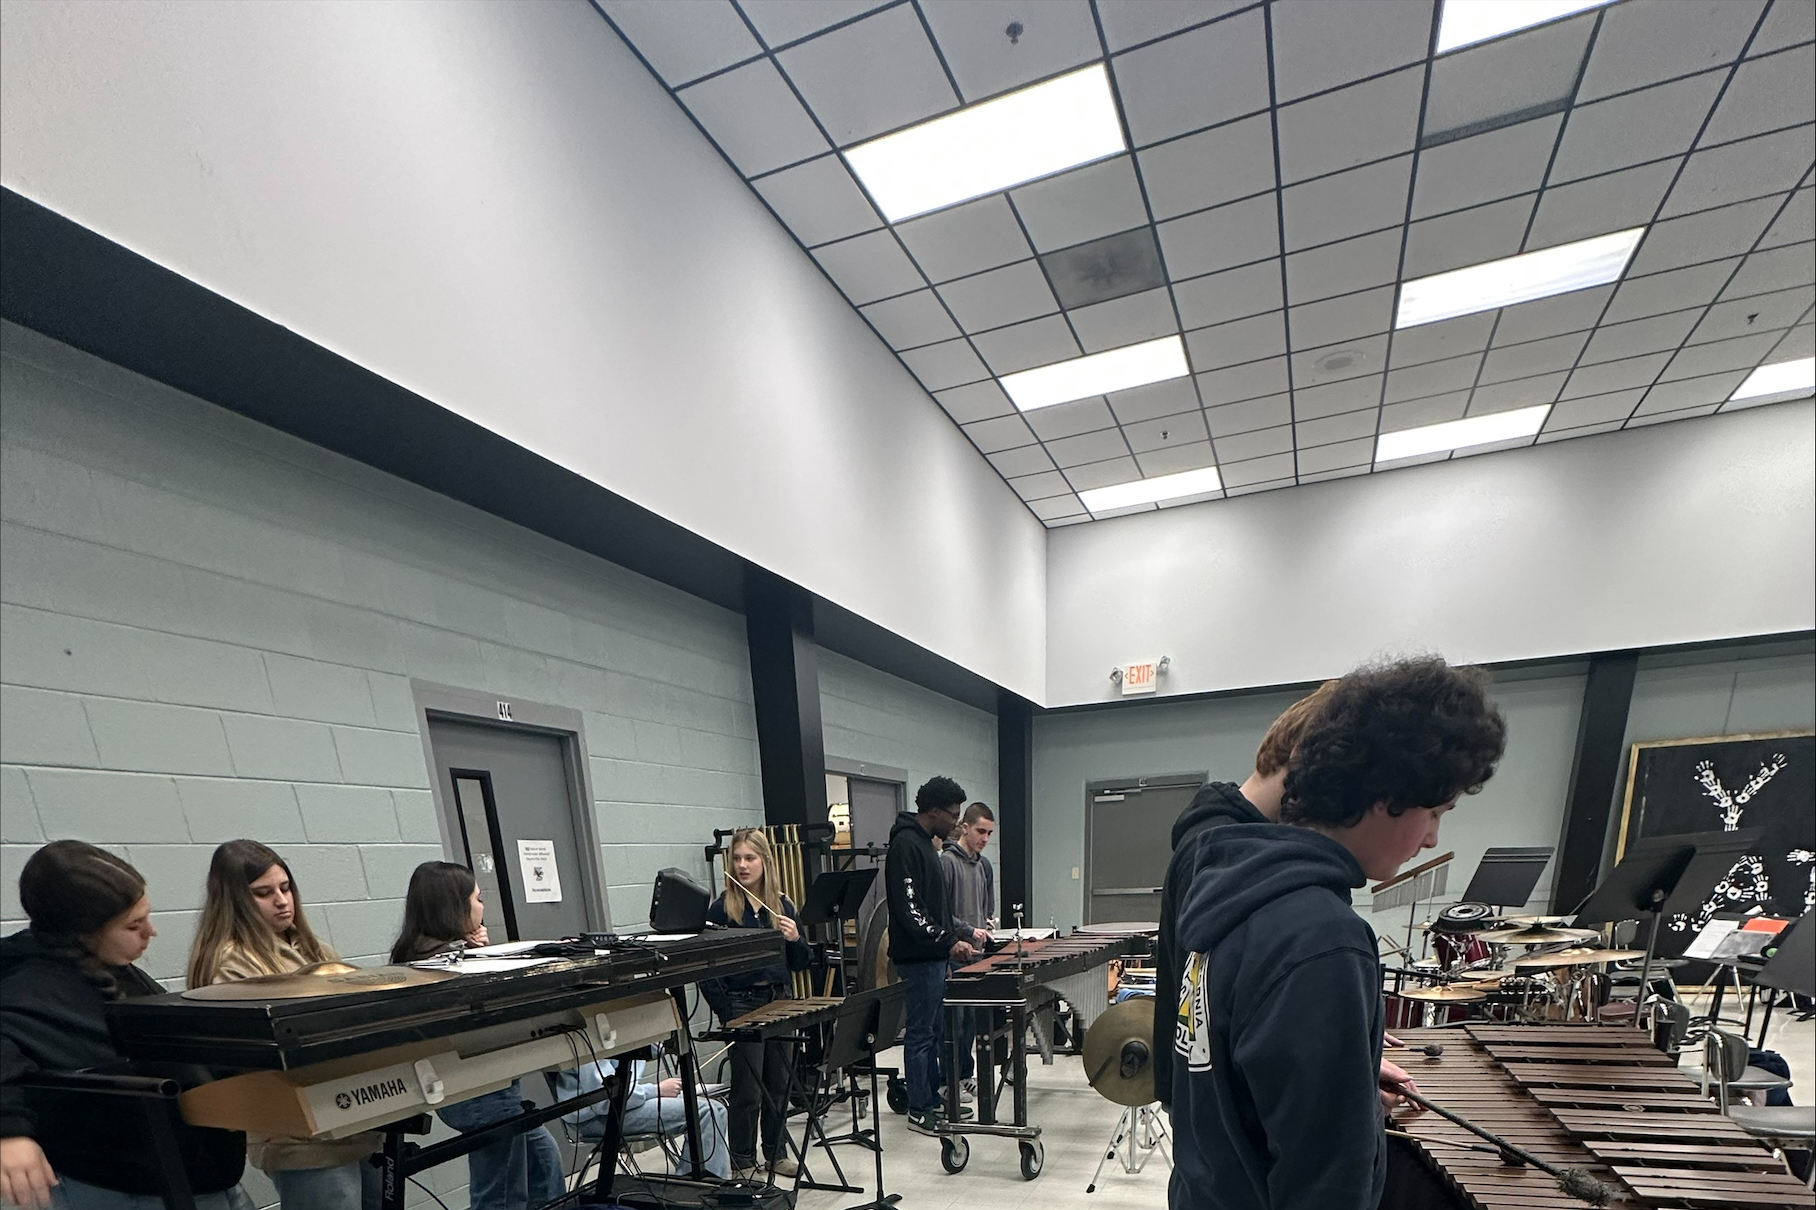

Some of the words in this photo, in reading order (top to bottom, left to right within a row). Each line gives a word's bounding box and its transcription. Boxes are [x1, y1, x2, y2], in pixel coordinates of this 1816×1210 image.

[1129, 664, 1152, 684] EXIT
[499, 702, 512, 719] 414
[351, 1078, 407, 1106] YAMAHA
[385, 1156, 395, 1201] Roland
